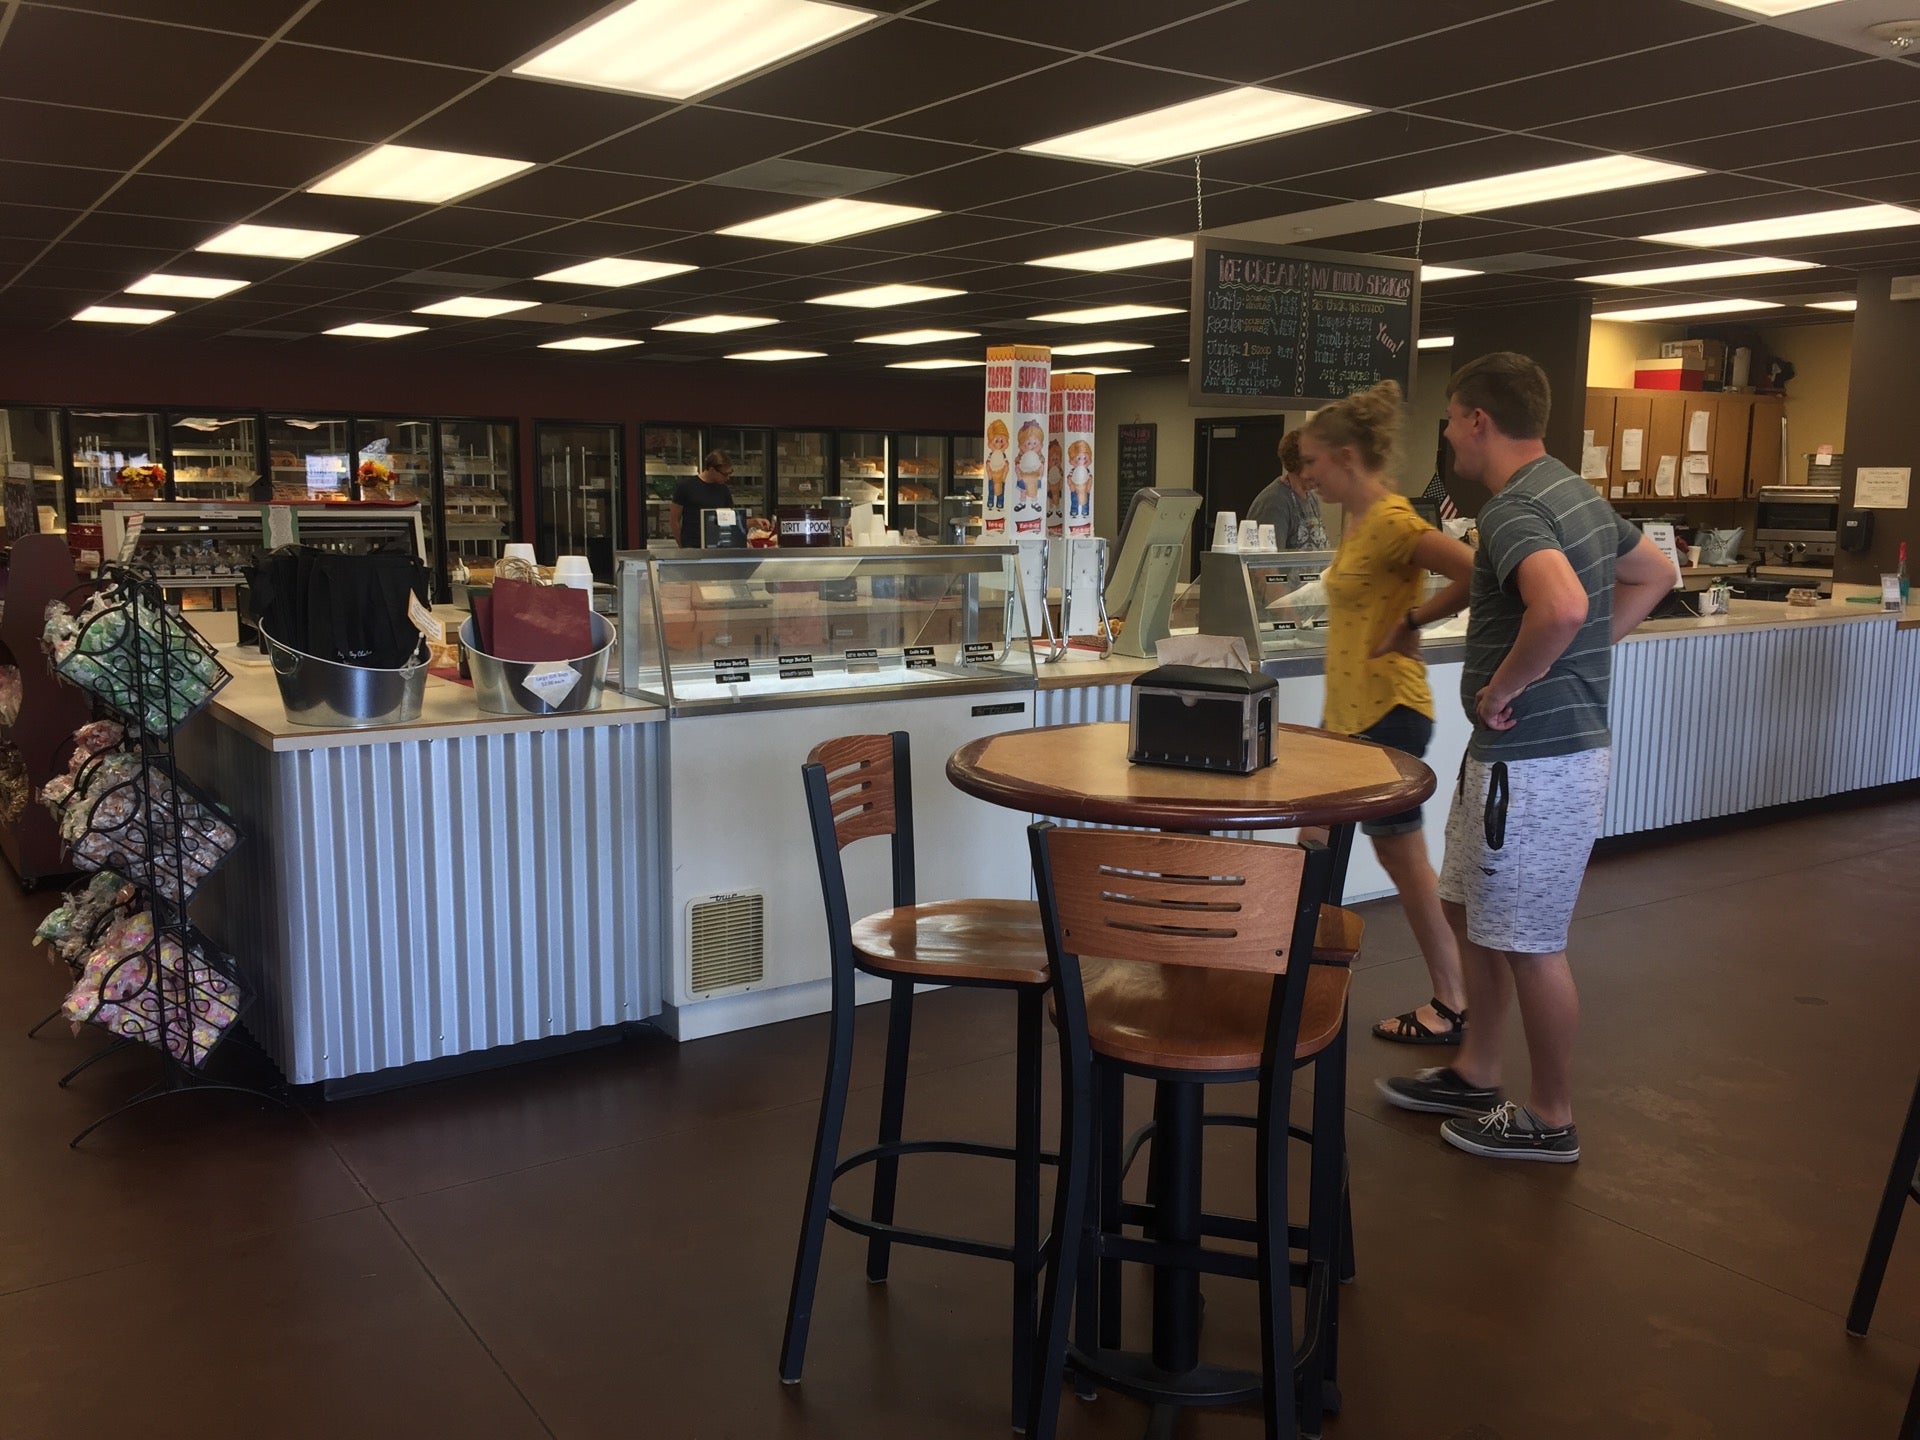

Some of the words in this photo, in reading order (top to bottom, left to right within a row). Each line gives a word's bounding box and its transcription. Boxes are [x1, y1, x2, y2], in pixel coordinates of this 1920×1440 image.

[1375, 322, 1404, 358] Yum!
[1018, 366, 1047, 389] SUPER
[1017, 391, 1047, 414] TREAT!
[1067, 413, 1093, 432] GREAT!
